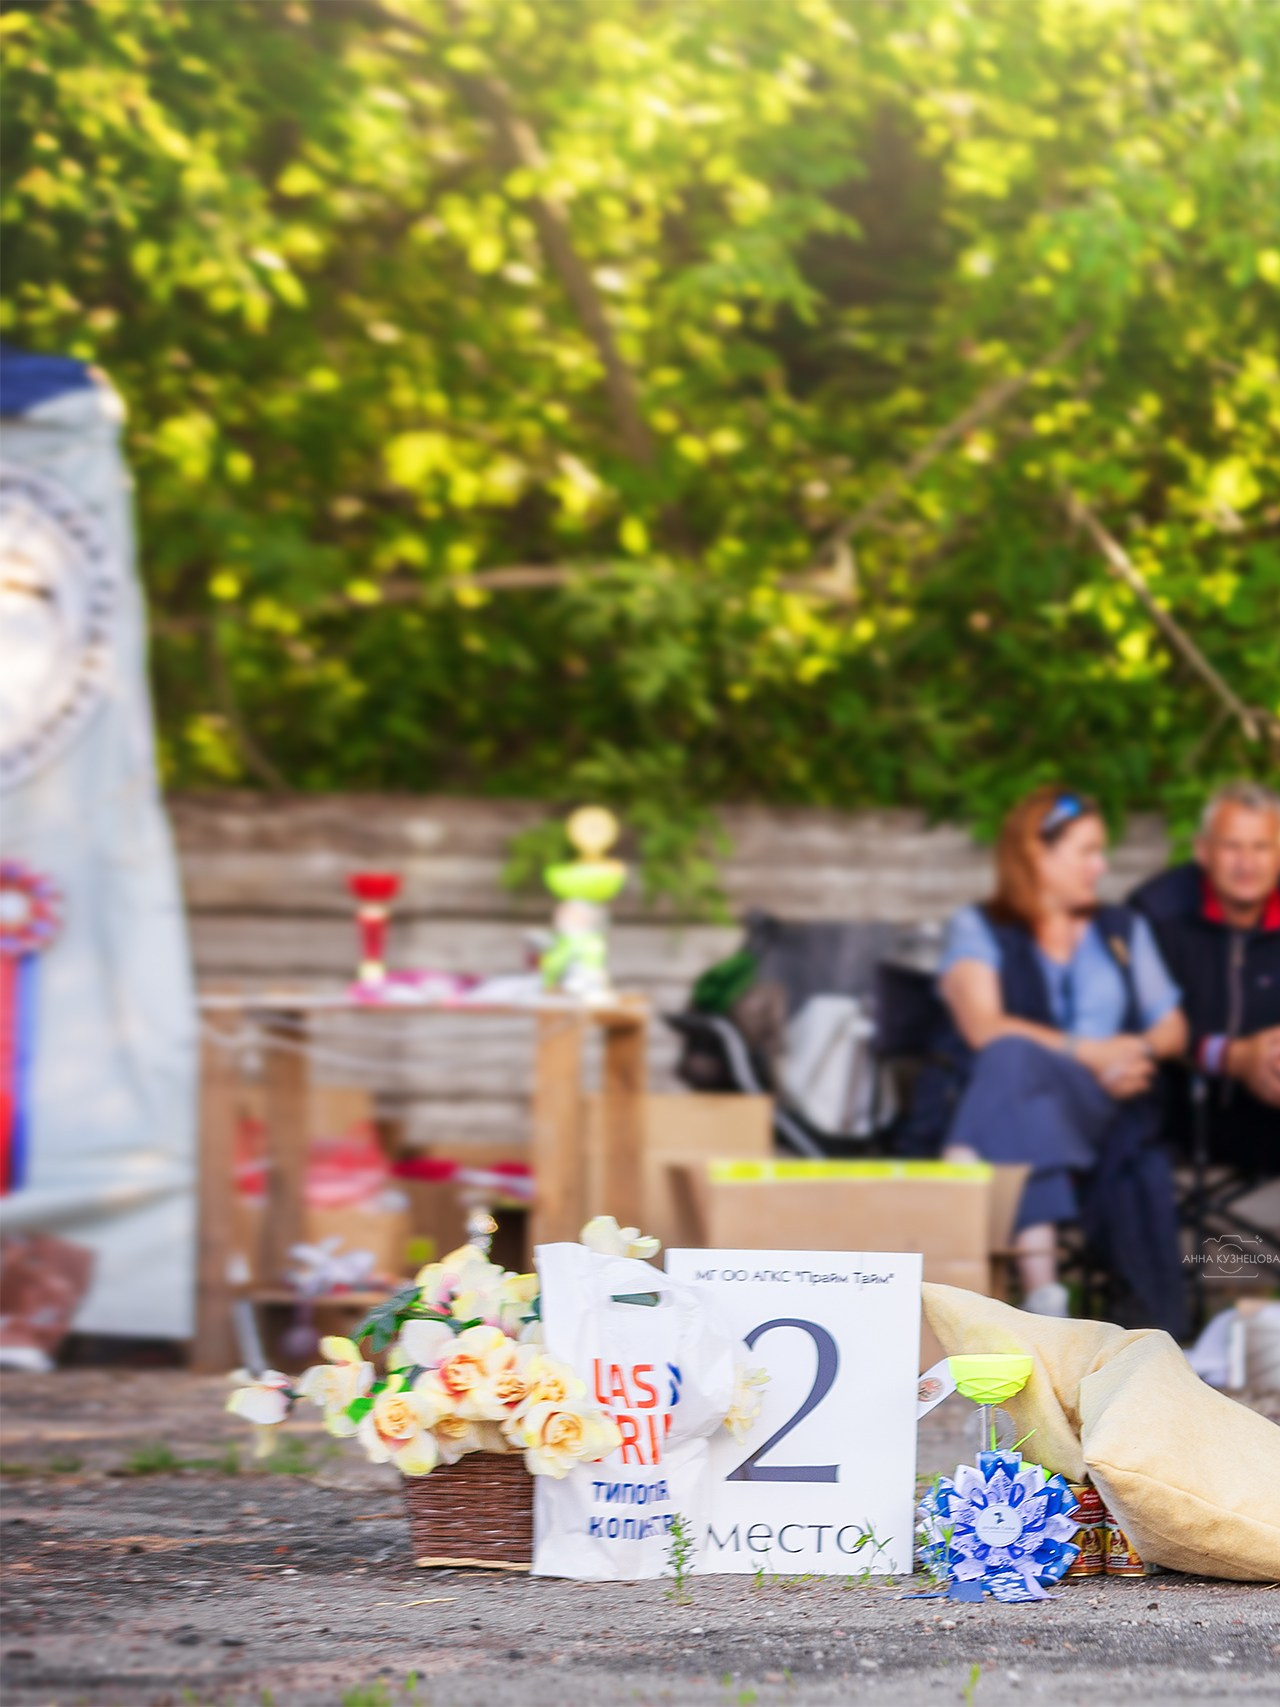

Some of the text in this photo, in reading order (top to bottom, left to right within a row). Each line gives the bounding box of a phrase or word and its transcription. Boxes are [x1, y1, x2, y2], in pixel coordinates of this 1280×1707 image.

[722, 1269, 748, 1282] ОО
[725, 1317, 841, 1484] 2
[705, 1522, 868, 1555] место
